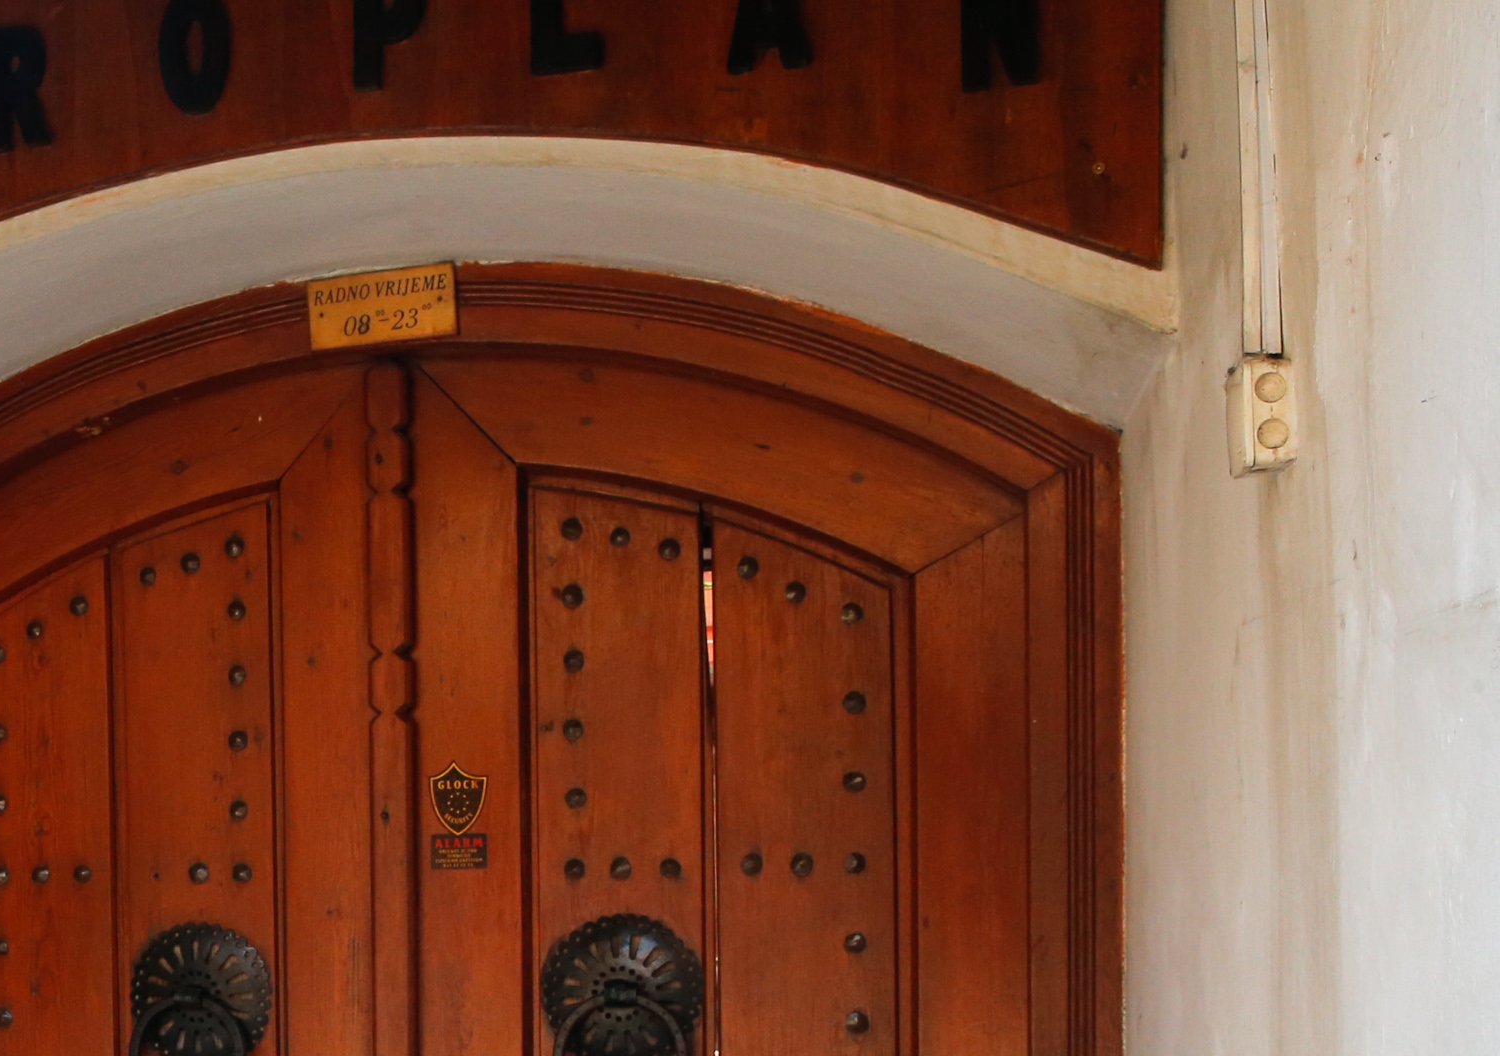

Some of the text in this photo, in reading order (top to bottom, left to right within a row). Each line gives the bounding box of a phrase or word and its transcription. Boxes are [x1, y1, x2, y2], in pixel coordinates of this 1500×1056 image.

[313, 273, 448, 307] RADNO VRIJEME
[437, 780, 479, 790] GLOCK
[435, 838, 484, 848] ALARM
